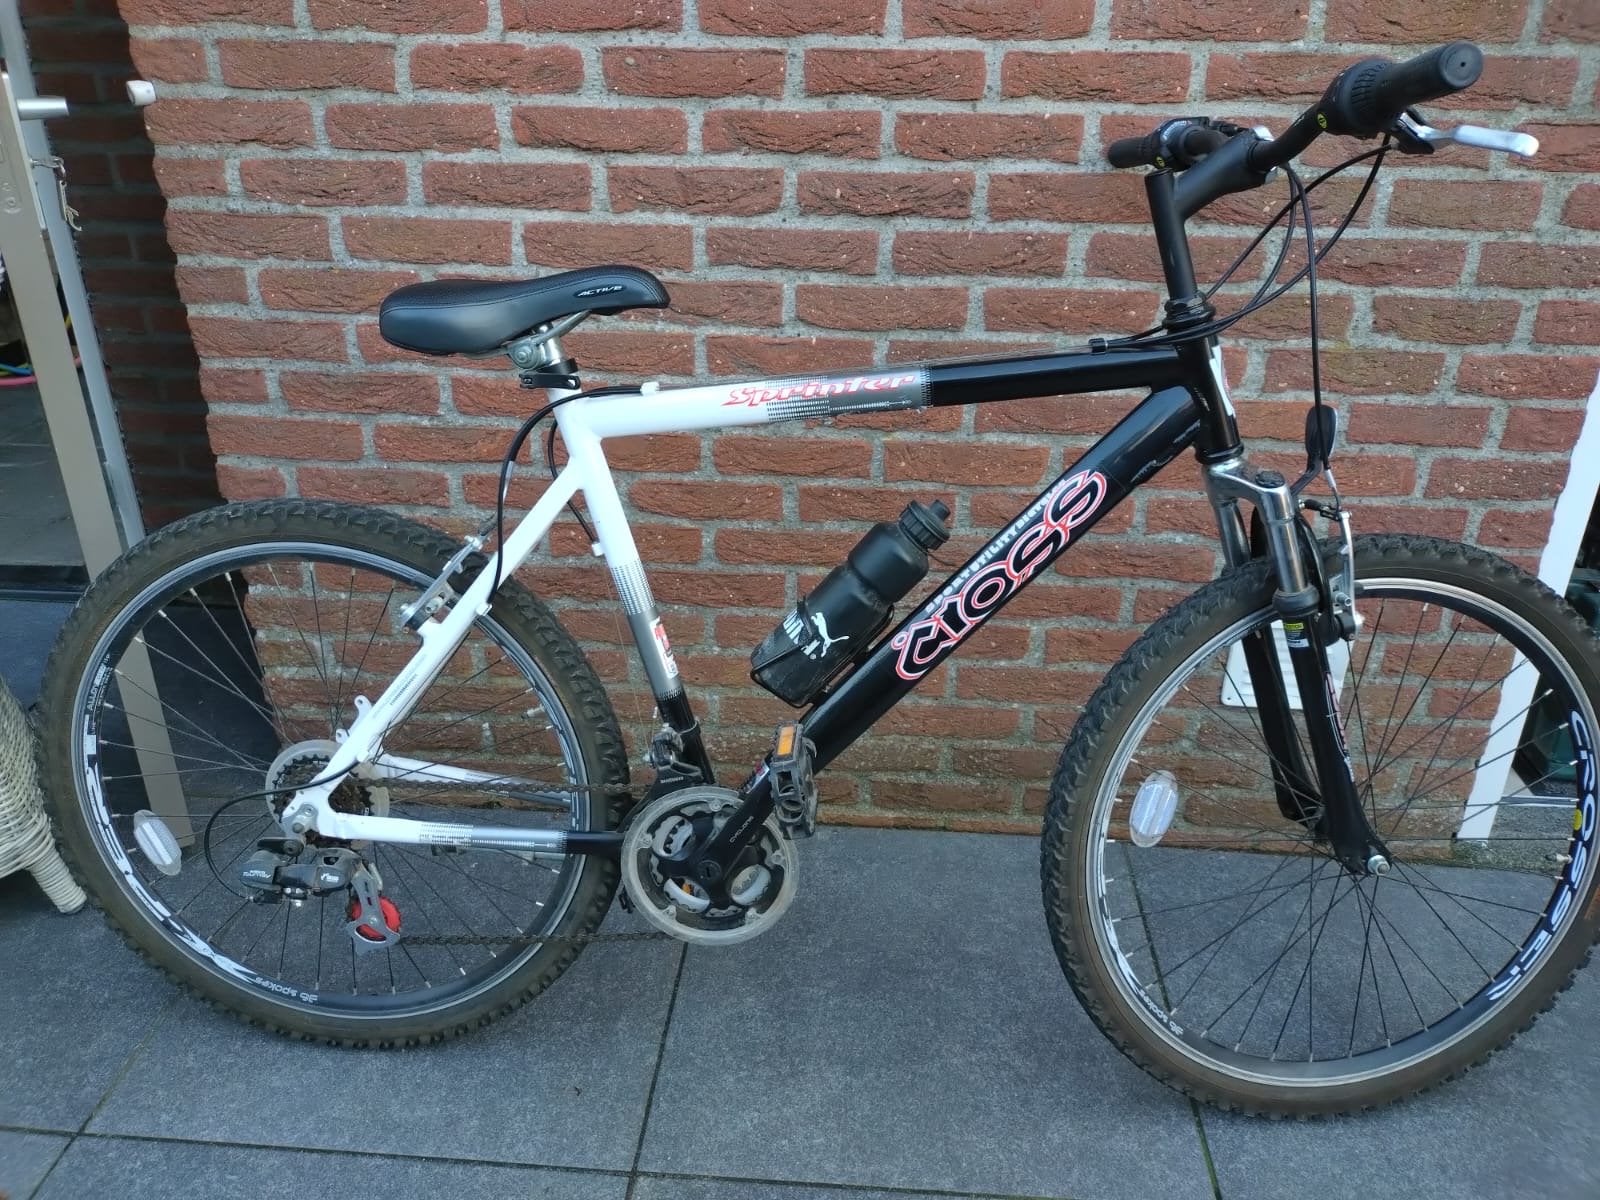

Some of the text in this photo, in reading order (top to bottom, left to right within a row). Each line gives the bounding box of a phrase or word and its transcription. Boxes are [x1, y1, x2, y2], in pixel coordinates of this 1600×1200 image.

[577, 285, 622, 297] ACTIVE
[720, 375, 916, 408] Sprinter
[1486, 710, 1596, 1001] CROSSER
